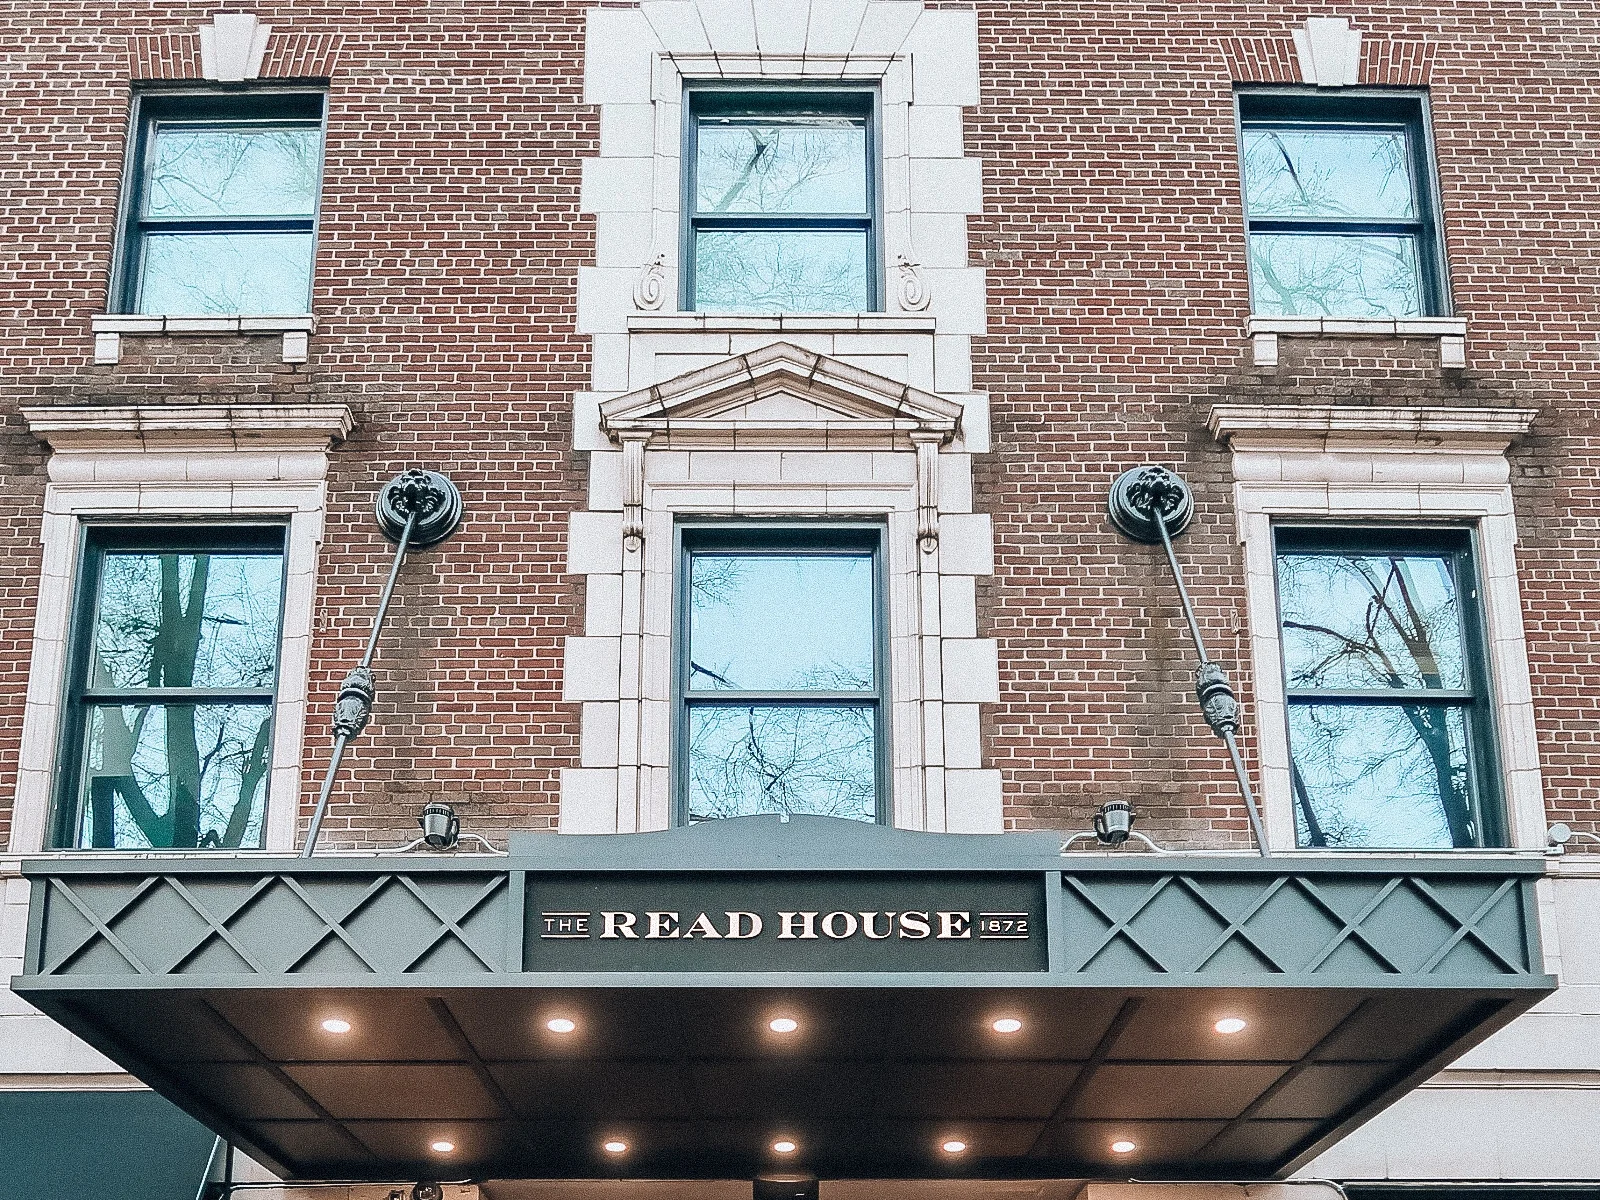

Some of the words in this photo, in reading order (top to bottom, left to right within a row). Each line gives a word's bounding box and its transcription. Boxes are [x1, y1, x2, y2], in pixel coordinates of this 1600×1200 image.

[543, 918, 589, 932] THE
[599, 911, 763, 939] READ
[776, 910, 972, 939] HOUSE
[980, 920, 1029, 932] 1872
